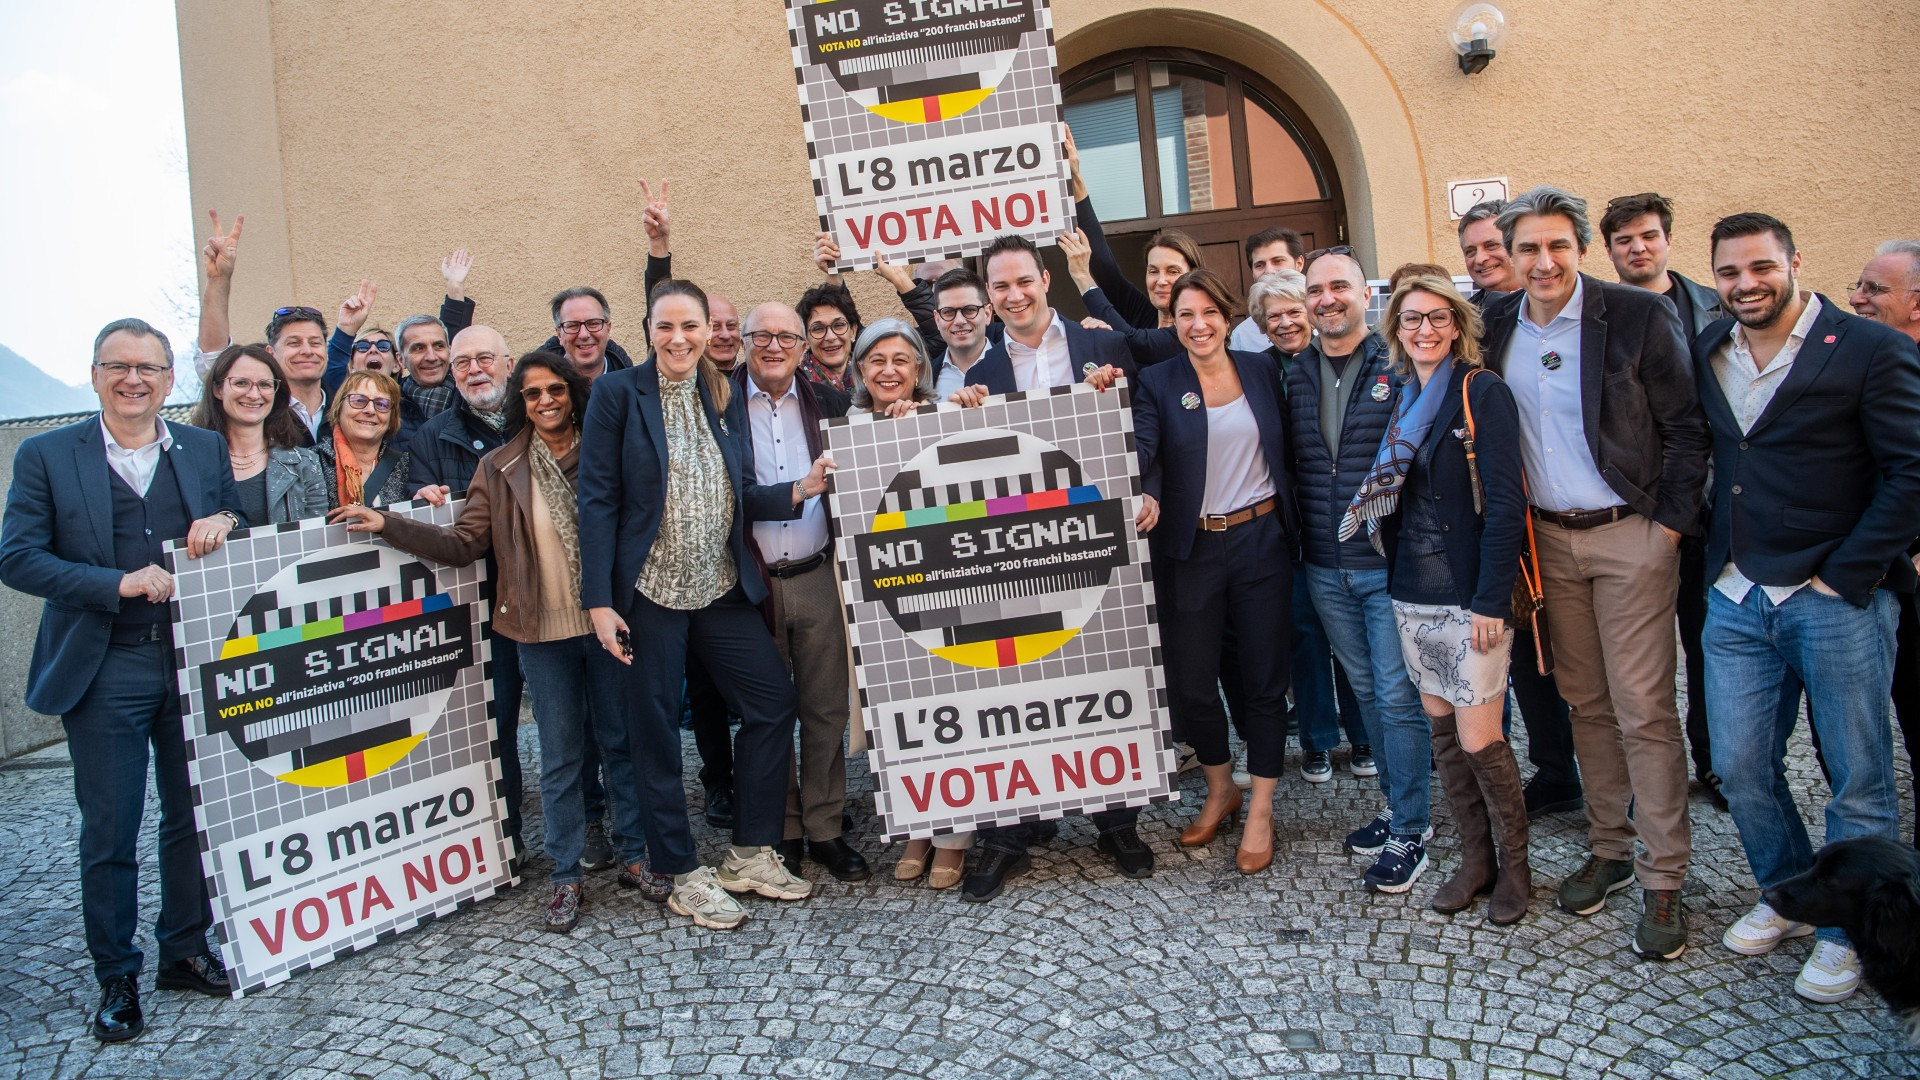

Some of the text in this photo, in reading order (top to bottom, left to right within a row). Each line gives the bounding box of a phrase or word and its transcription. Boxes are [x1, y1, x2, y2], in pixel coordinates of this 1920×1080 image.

[814, 9, 860, 37] NO
[819, 42, 845, 53] VOTA
[846, 39, 861, 49] NO
[945, 20, 979, 33] franchi
[907, 142, 1041, 187] marzo
[845, 190, 1050, 249] VOTA NO!
[868, 514, 1114, 570] NO SIGNAL
[873, 576, 905, 589] VOTA
[906, 573, 924, 585] NO
[1022, 553, 1062, 568] franchi
[215, 621, 462, 700] NO SIGNAL
[219, 702, 254, 719] VOTA
[255, 697, 274, 711] NO
[375, 660, 413, 680] franchi
[978, 688, 1133, 739] marzo
[901, 743, 1143, 812] VOTA NO!
[327, 786, 475, 862] marzo
[249, 836, 487, 956] VOTA NO!
[688, 892, 709, 907] N
